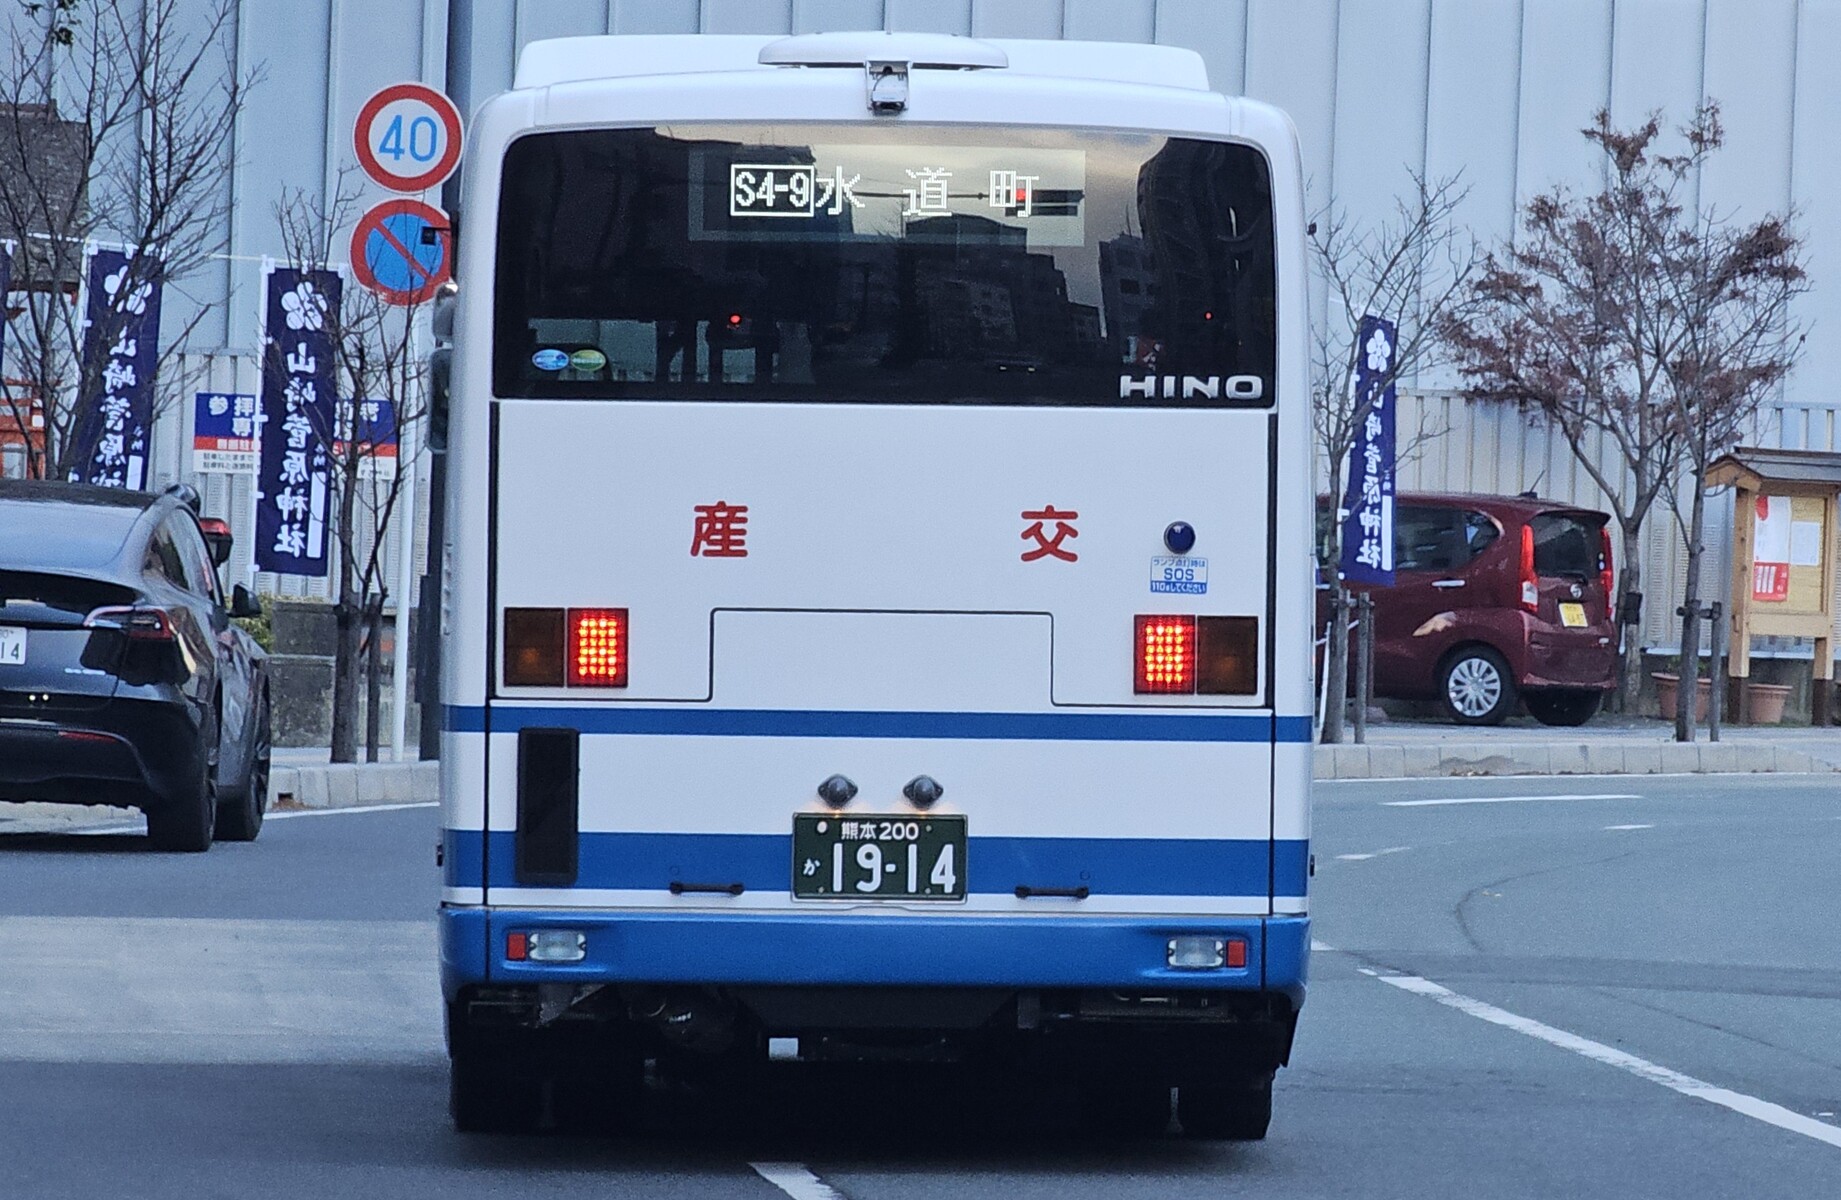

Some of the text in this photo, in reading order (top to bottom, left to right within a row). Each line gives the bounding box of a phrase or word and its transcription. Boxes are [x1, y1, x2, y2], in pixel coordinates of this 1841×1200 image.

[379, 115, 438, 162] 40
[735, 165, 1039, 218] S4-9 水道町
[1120, 375, 1263, 399] HINO
[690, 500, 1079, 563] 産 交
[1164, 567, 1195, 581] SOS
[803, 842, 956, 894] か 19-14
